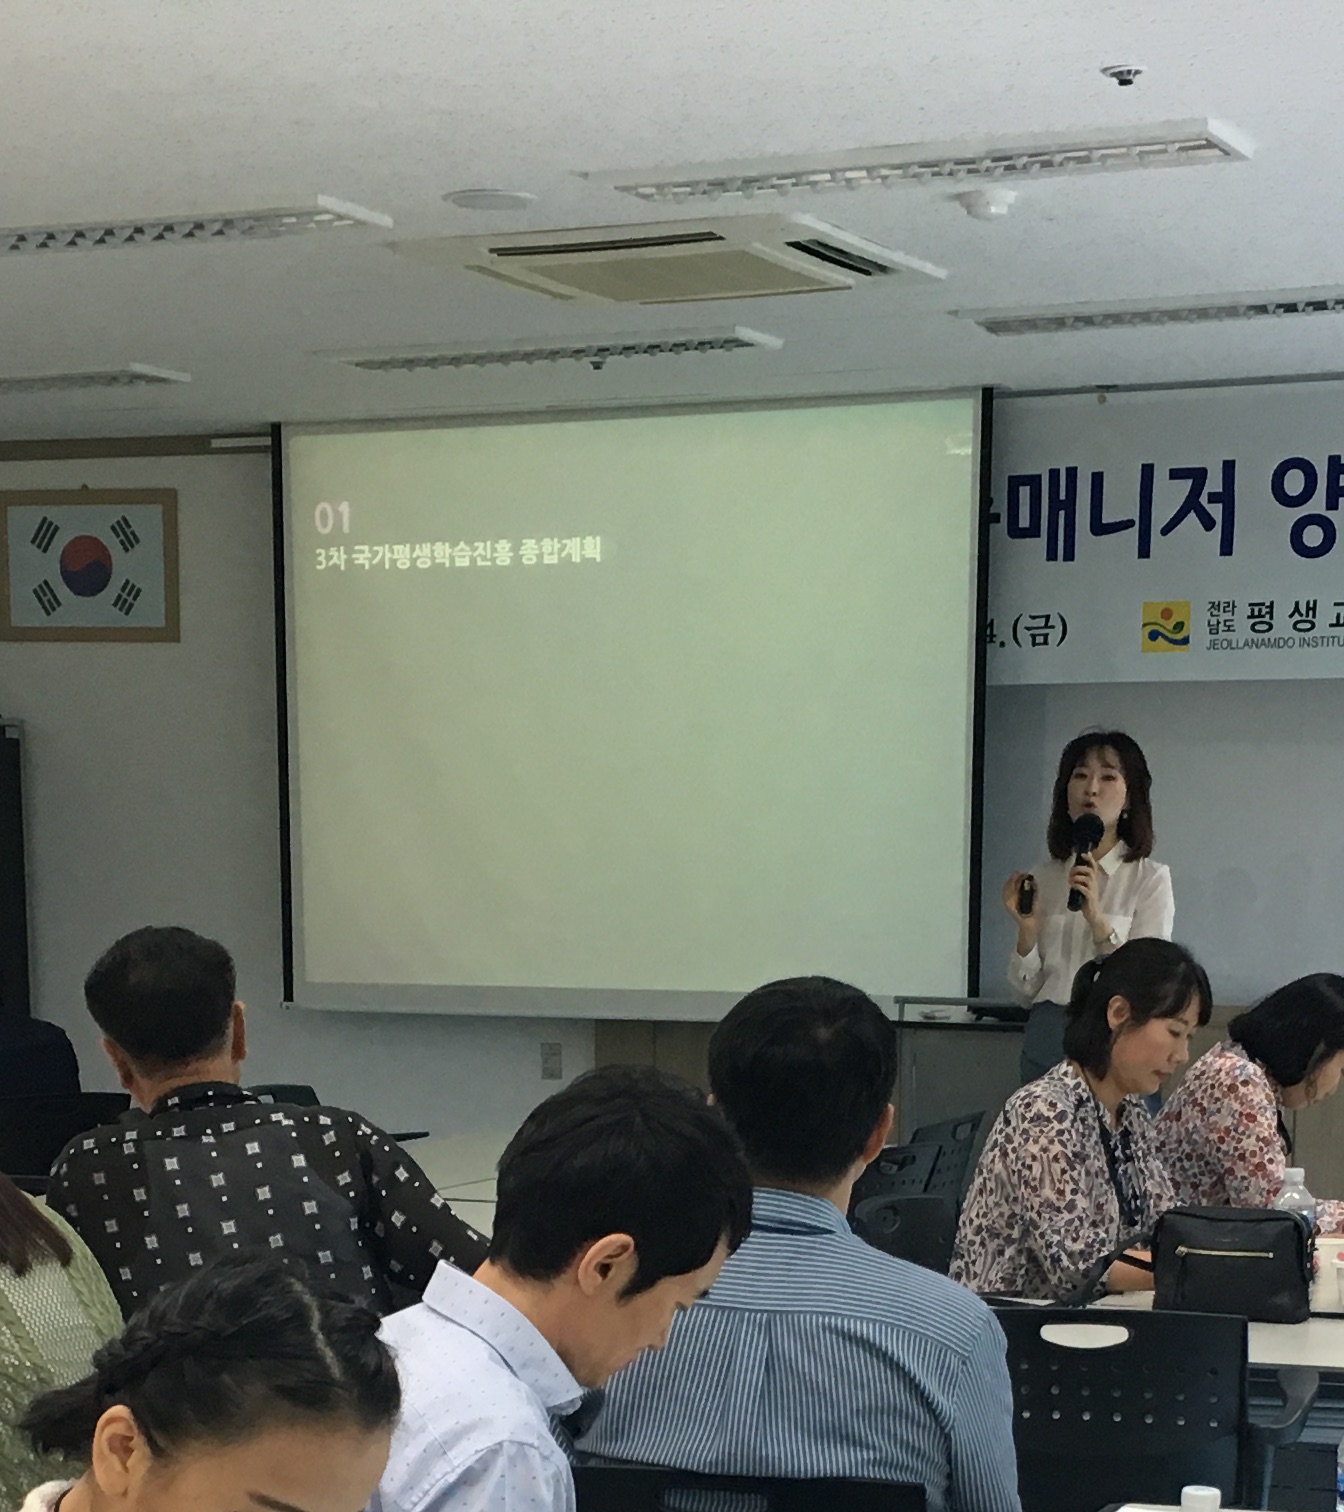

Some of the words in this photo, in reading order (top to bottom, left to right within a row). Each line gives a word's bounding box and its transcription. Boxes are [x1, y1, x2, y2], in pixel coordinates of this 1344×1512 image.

[314, 501, 350, 534] 01
[980, 459, 1236, 562] 매니저
[315, 545, 347, 571] 3차
[351, 539, 514, 570] 국가평생학습진흥
[518, 535, 601, 565] 종합계획
[1207, 600, 1238, 617] 전라
[1207, 618, 1236, 636] 남도
[1206, 636, 1296, 651] JEOLLANAMDO
